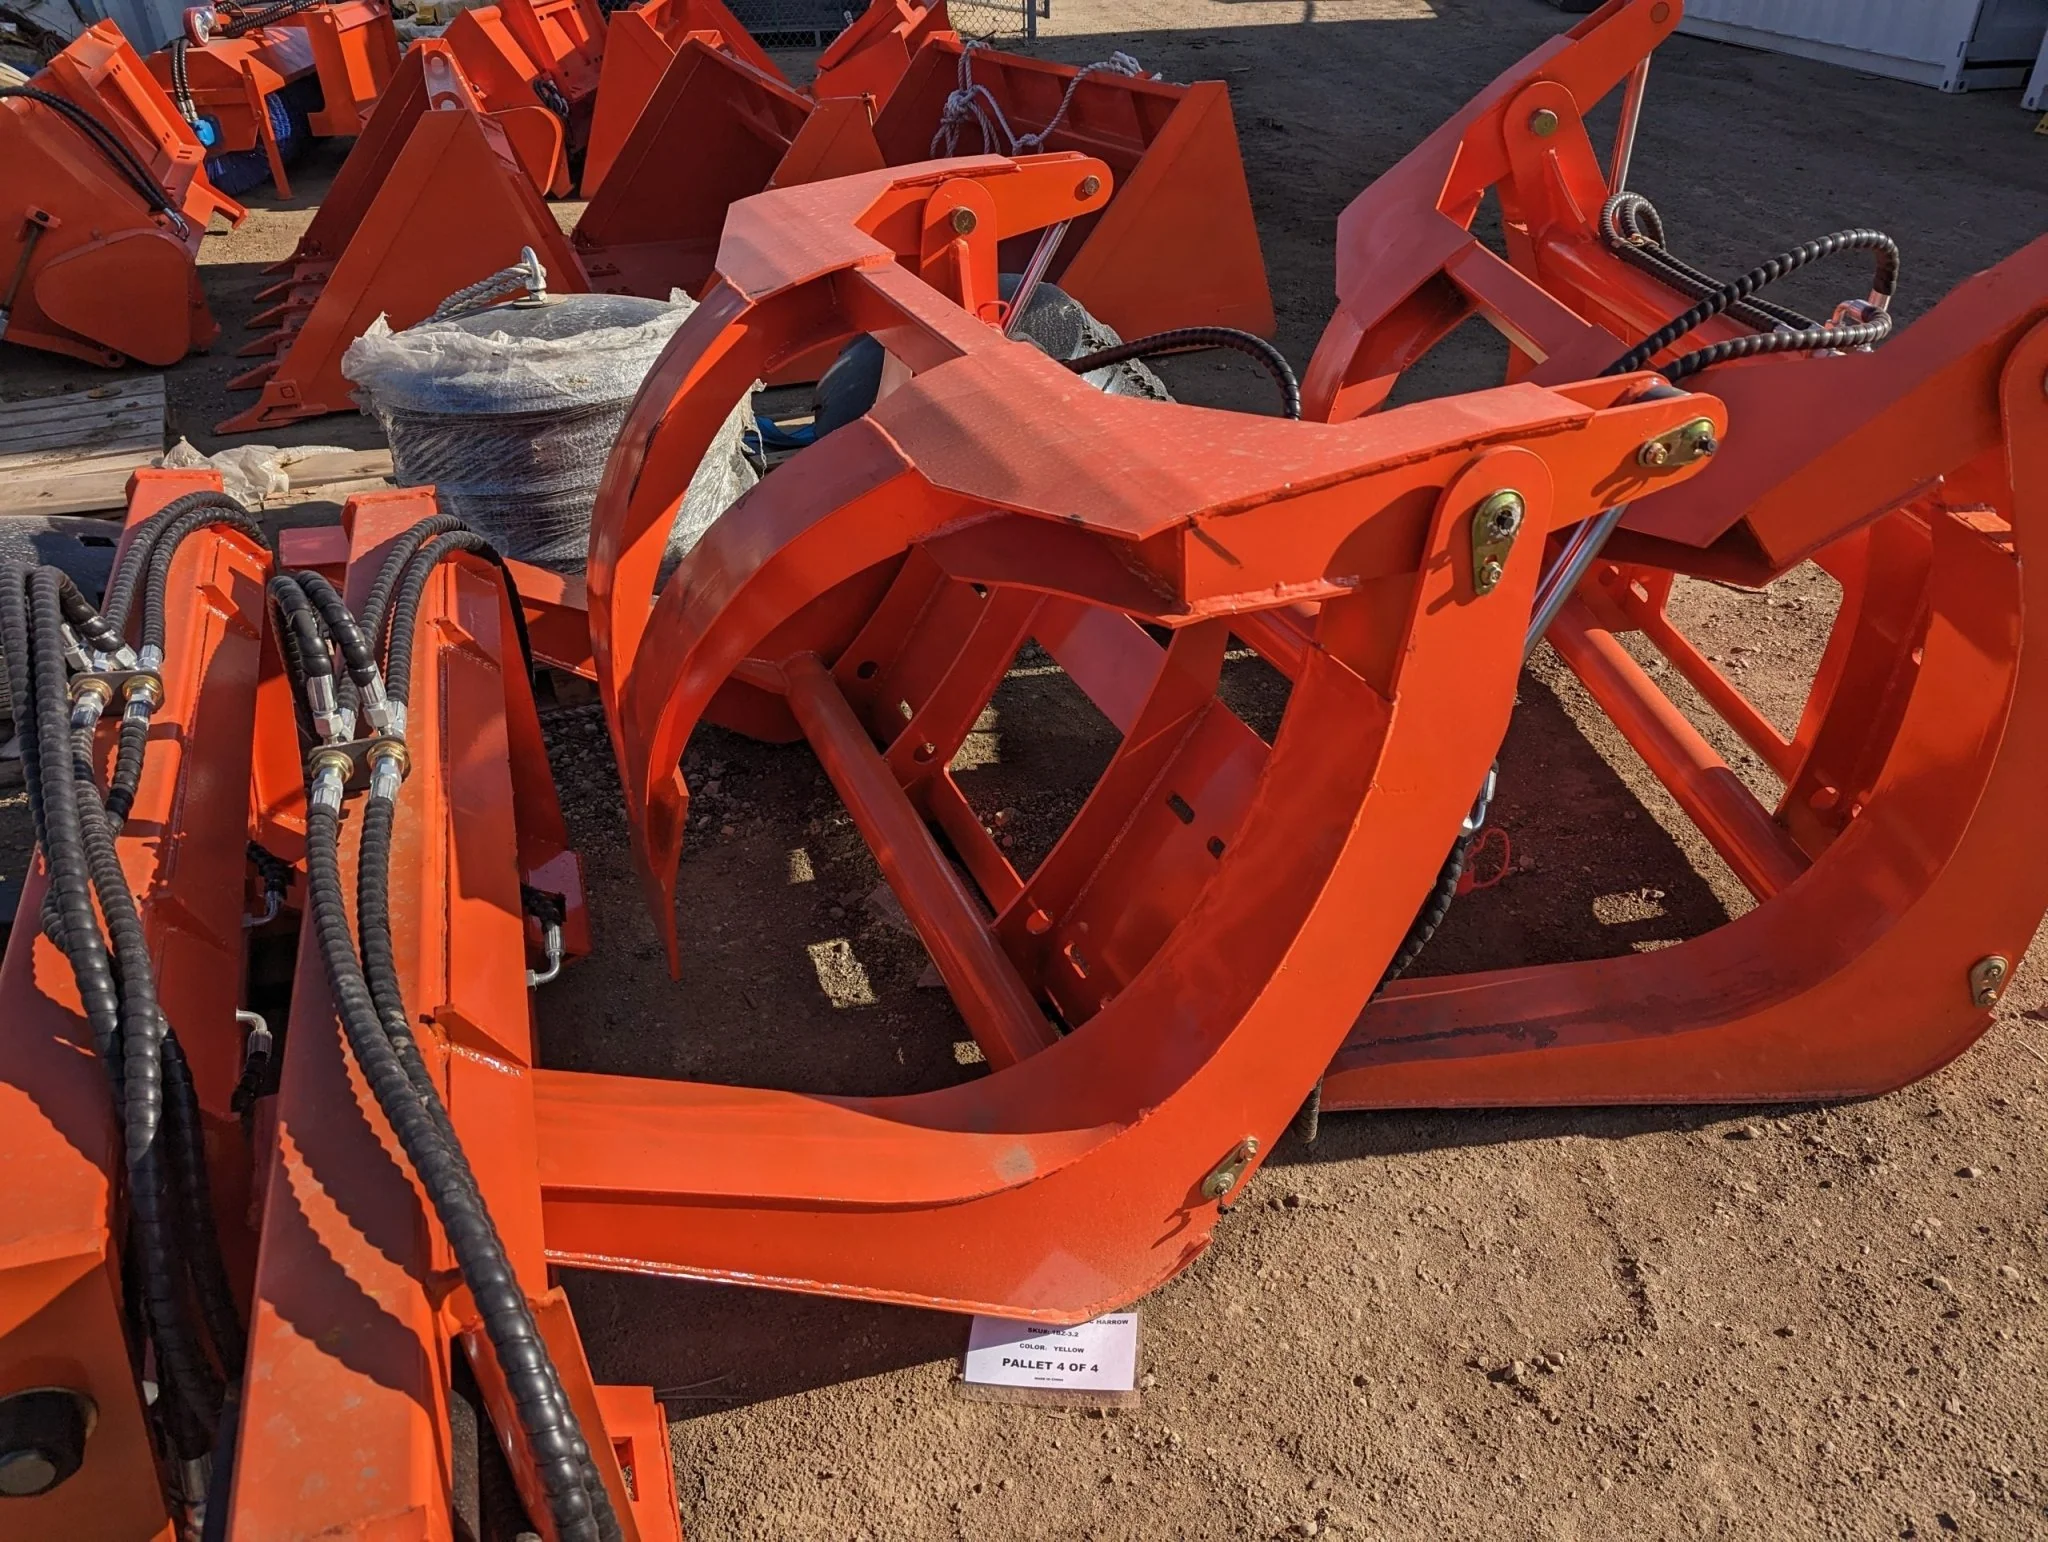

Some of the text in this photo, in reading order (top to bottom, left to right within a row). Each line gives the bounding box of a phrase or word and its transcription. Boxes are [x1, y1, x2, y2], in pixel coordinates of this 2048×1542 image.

[1002, 1358, 1099, 1373] PALLET 4 OF 4
